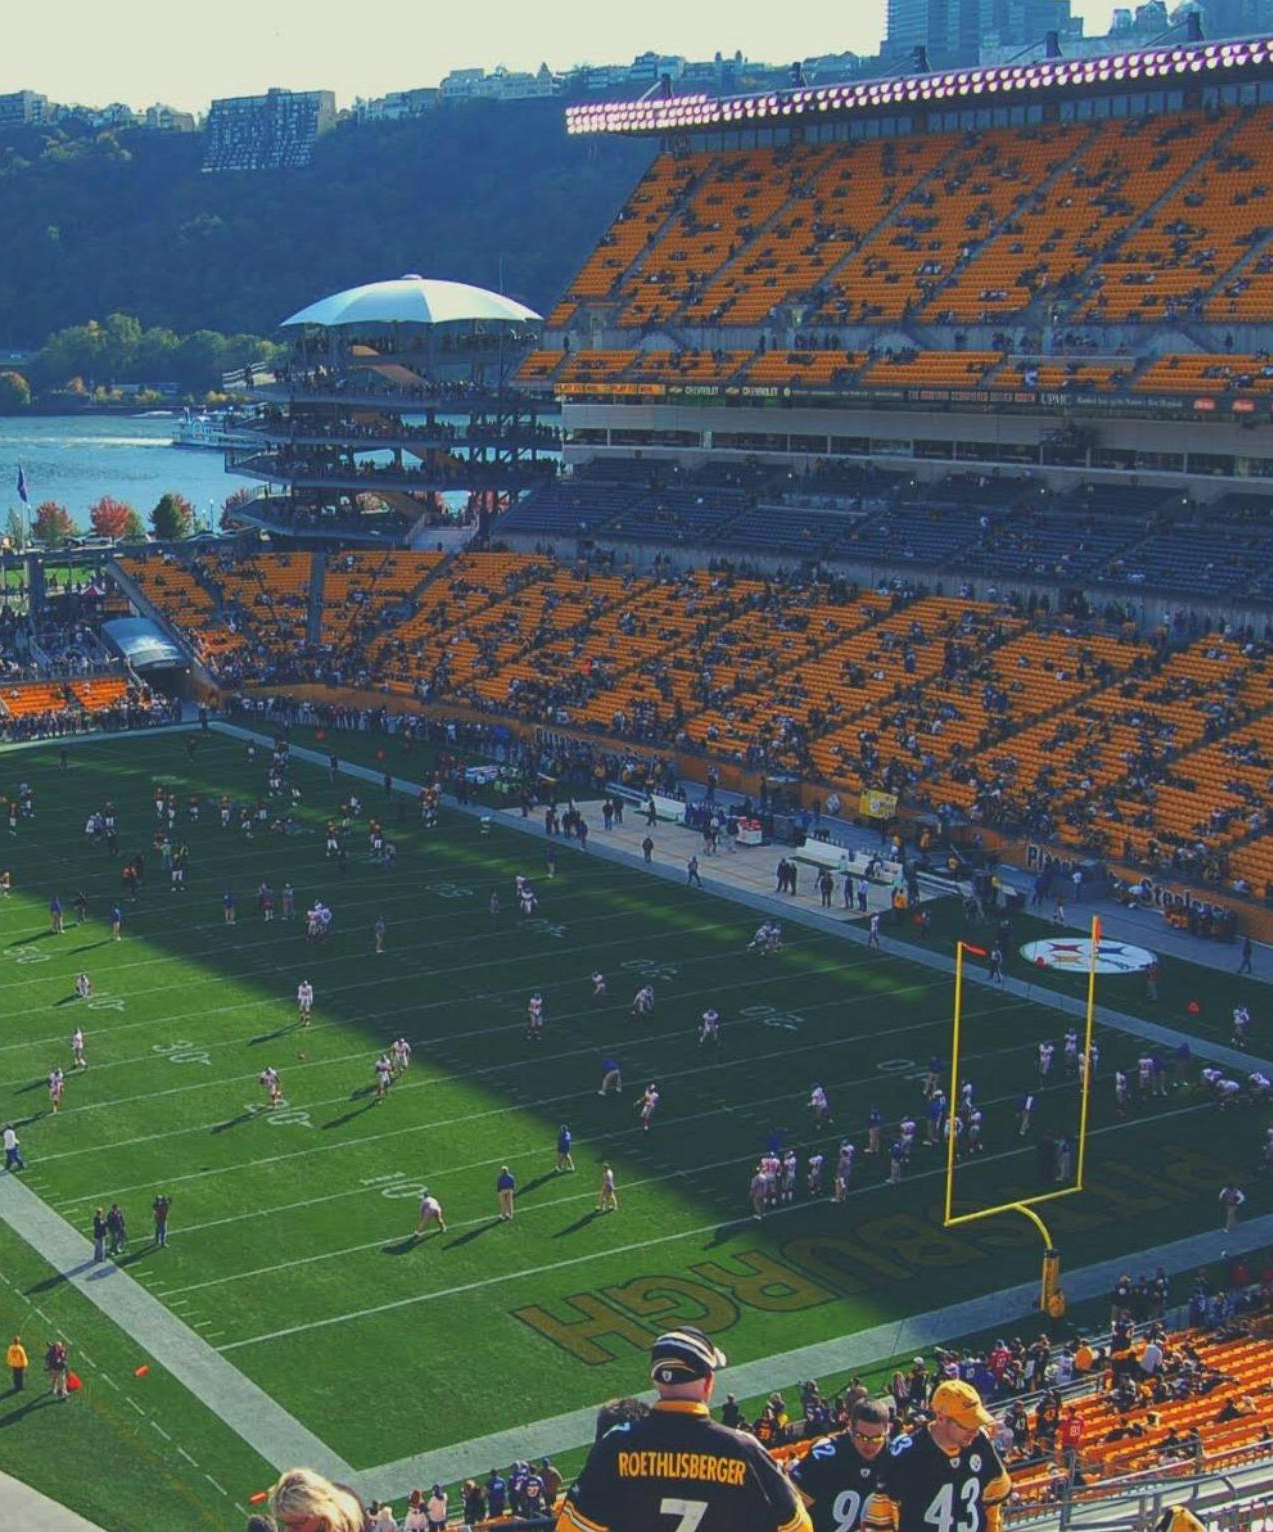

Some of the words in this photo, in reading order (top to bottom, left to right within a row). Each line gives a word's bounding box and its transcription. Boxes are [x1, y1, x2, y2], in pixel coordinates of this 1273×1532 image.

[360, 1171, 429, 1199] 10
[618, 1451, 747, 1486] ROETHLISBERGER
[660, 1498, 709, 1532] 7
[924, 1476, 980, 1532] 43
